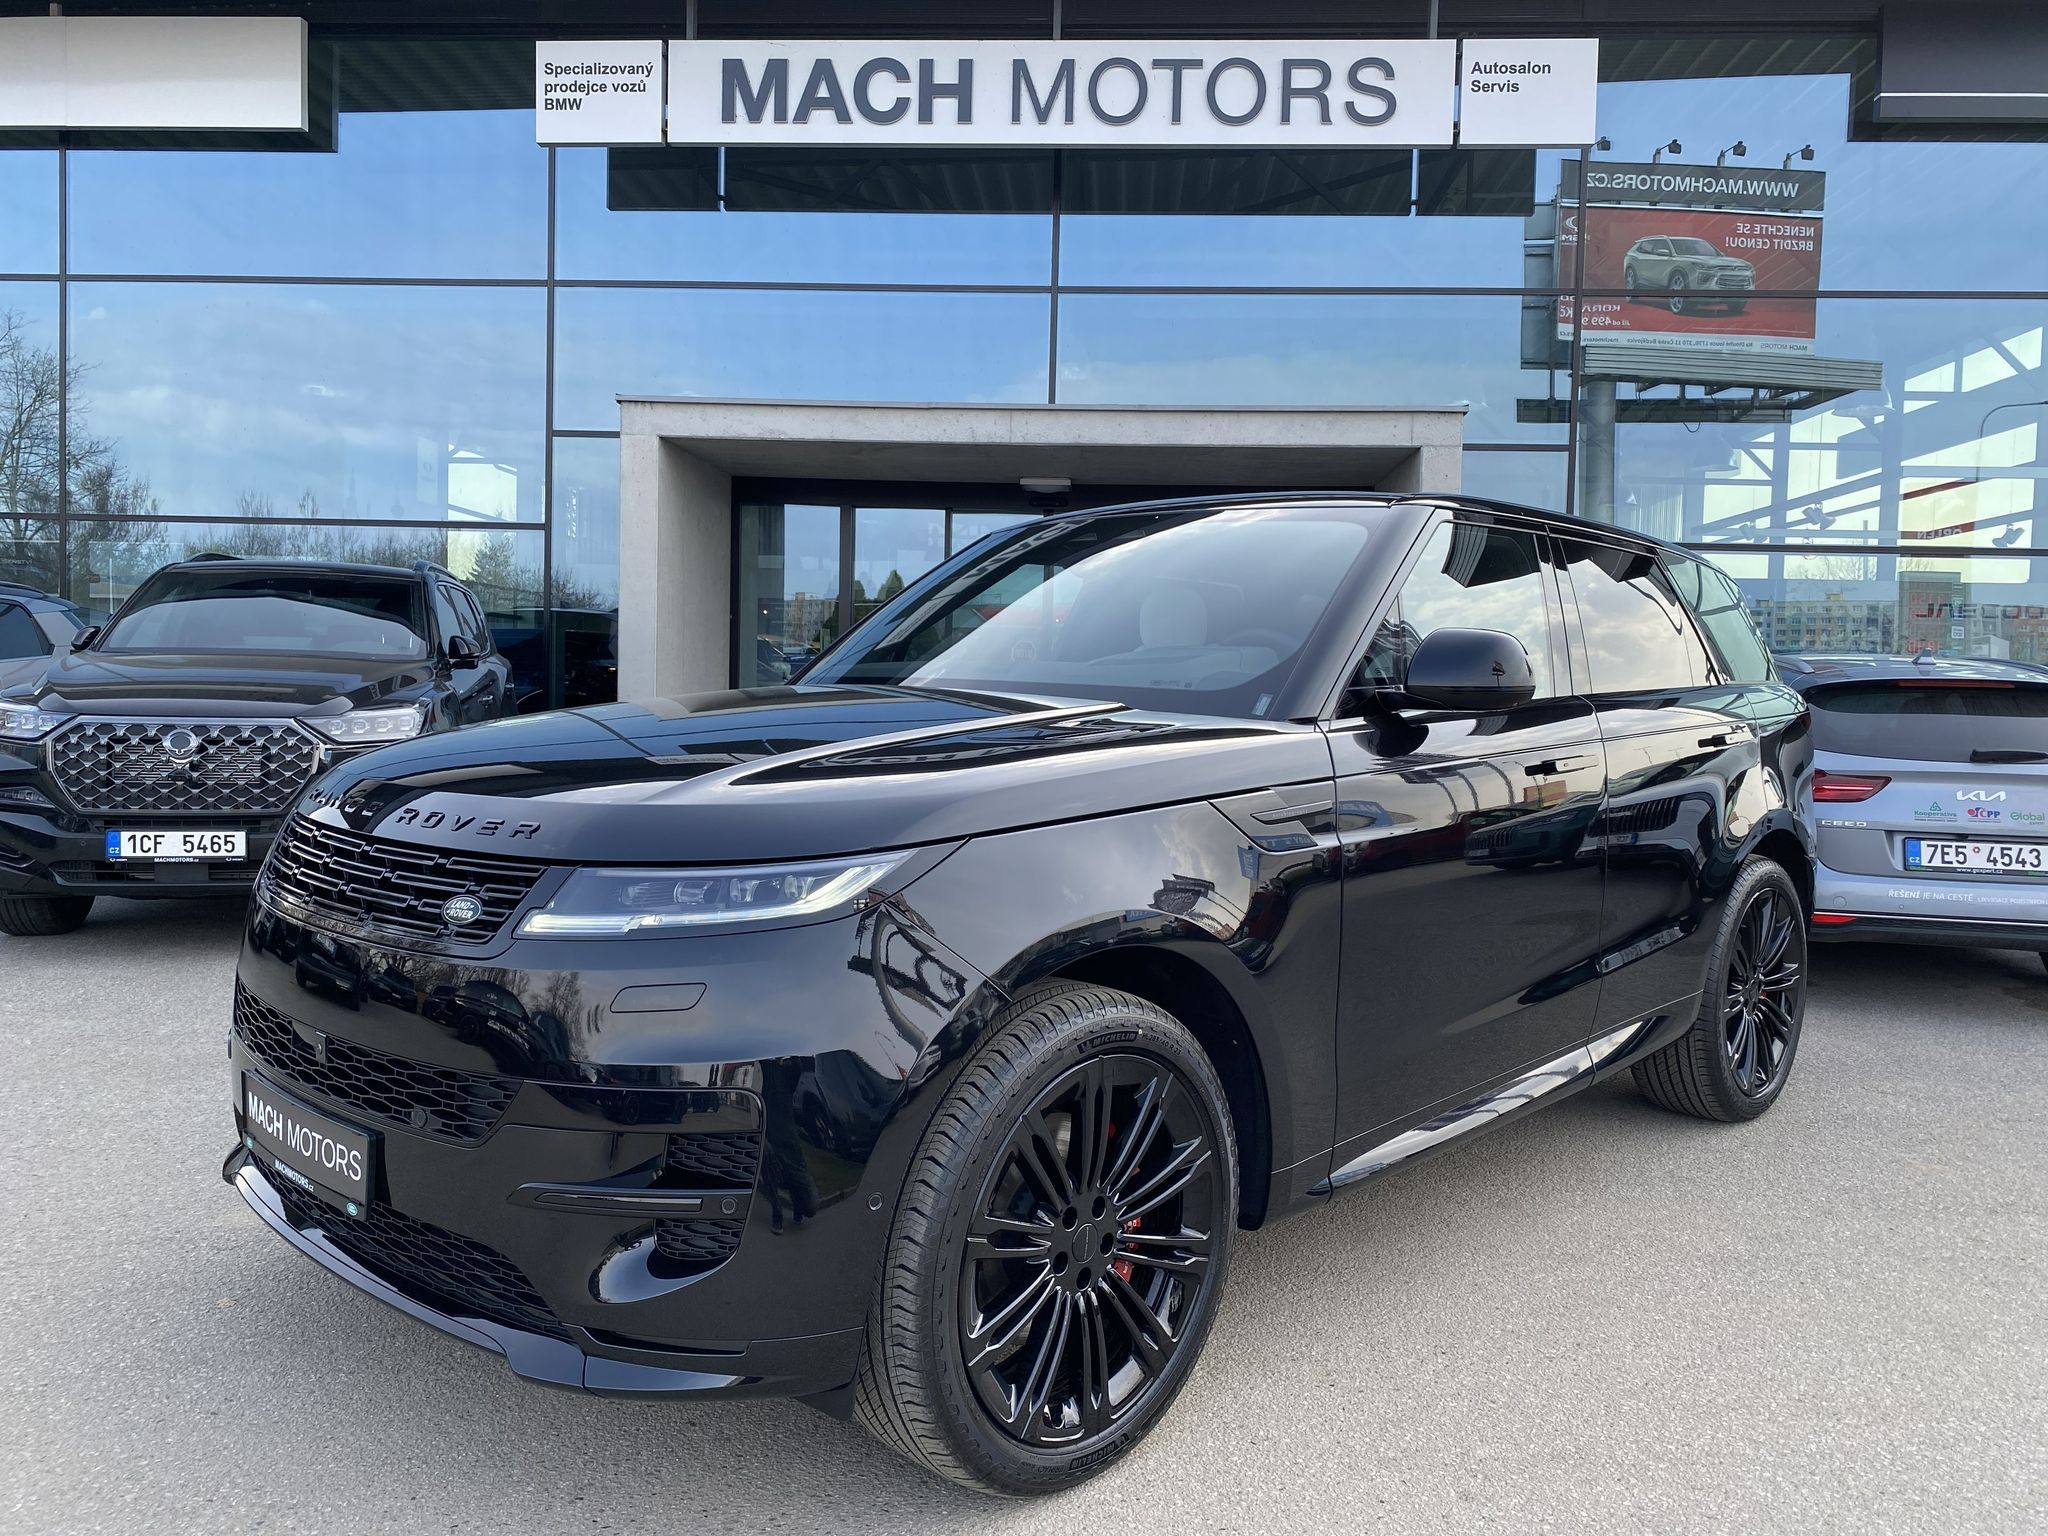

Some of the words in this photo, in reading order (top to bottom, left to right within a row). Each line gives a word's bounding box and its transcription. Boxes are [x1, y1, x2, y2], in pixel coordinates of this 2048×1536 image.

[544, 61, 654, 79] Specializovaný
[1471, 61, 1551, 75] Autosalon
[544, 79, 609, 96] prodejce
[611, 78, 647, 93] vozů
[721, 57, 974, 126] MACH
[1011, 57, 1398, 127] MOTORS
[1471, 79, 1520, 93] Servis
[544, 97, 583, 111] BMW
[1956, 790, 2006, 802] KIA
[307, 787, 385, 818] RANGE
[394, 806, 543, 840] ROVER
[127, 834, 166, 854] 1CF
[182, 834, 236, 854] 5465
[1909, 856, 1920, 864] CZ
[1926, 843, 1968, 865] 7E5
[1986, 846, 2042, 868] 4543
[450, 899, 471, 909] LAND
[1922, 892, 1932, 900] JE
[1933, 893, 1945, 901] NA
[448, 908, 473, 919] ROVER
[1092, 1031, 1137, 1048] MICHELIN
[248, 1090, 283, 1142] MACH
[287, 1118, 362, 1182] MOTORS
[274, 1158, 315, 1192] MACHMOTORS.cz
